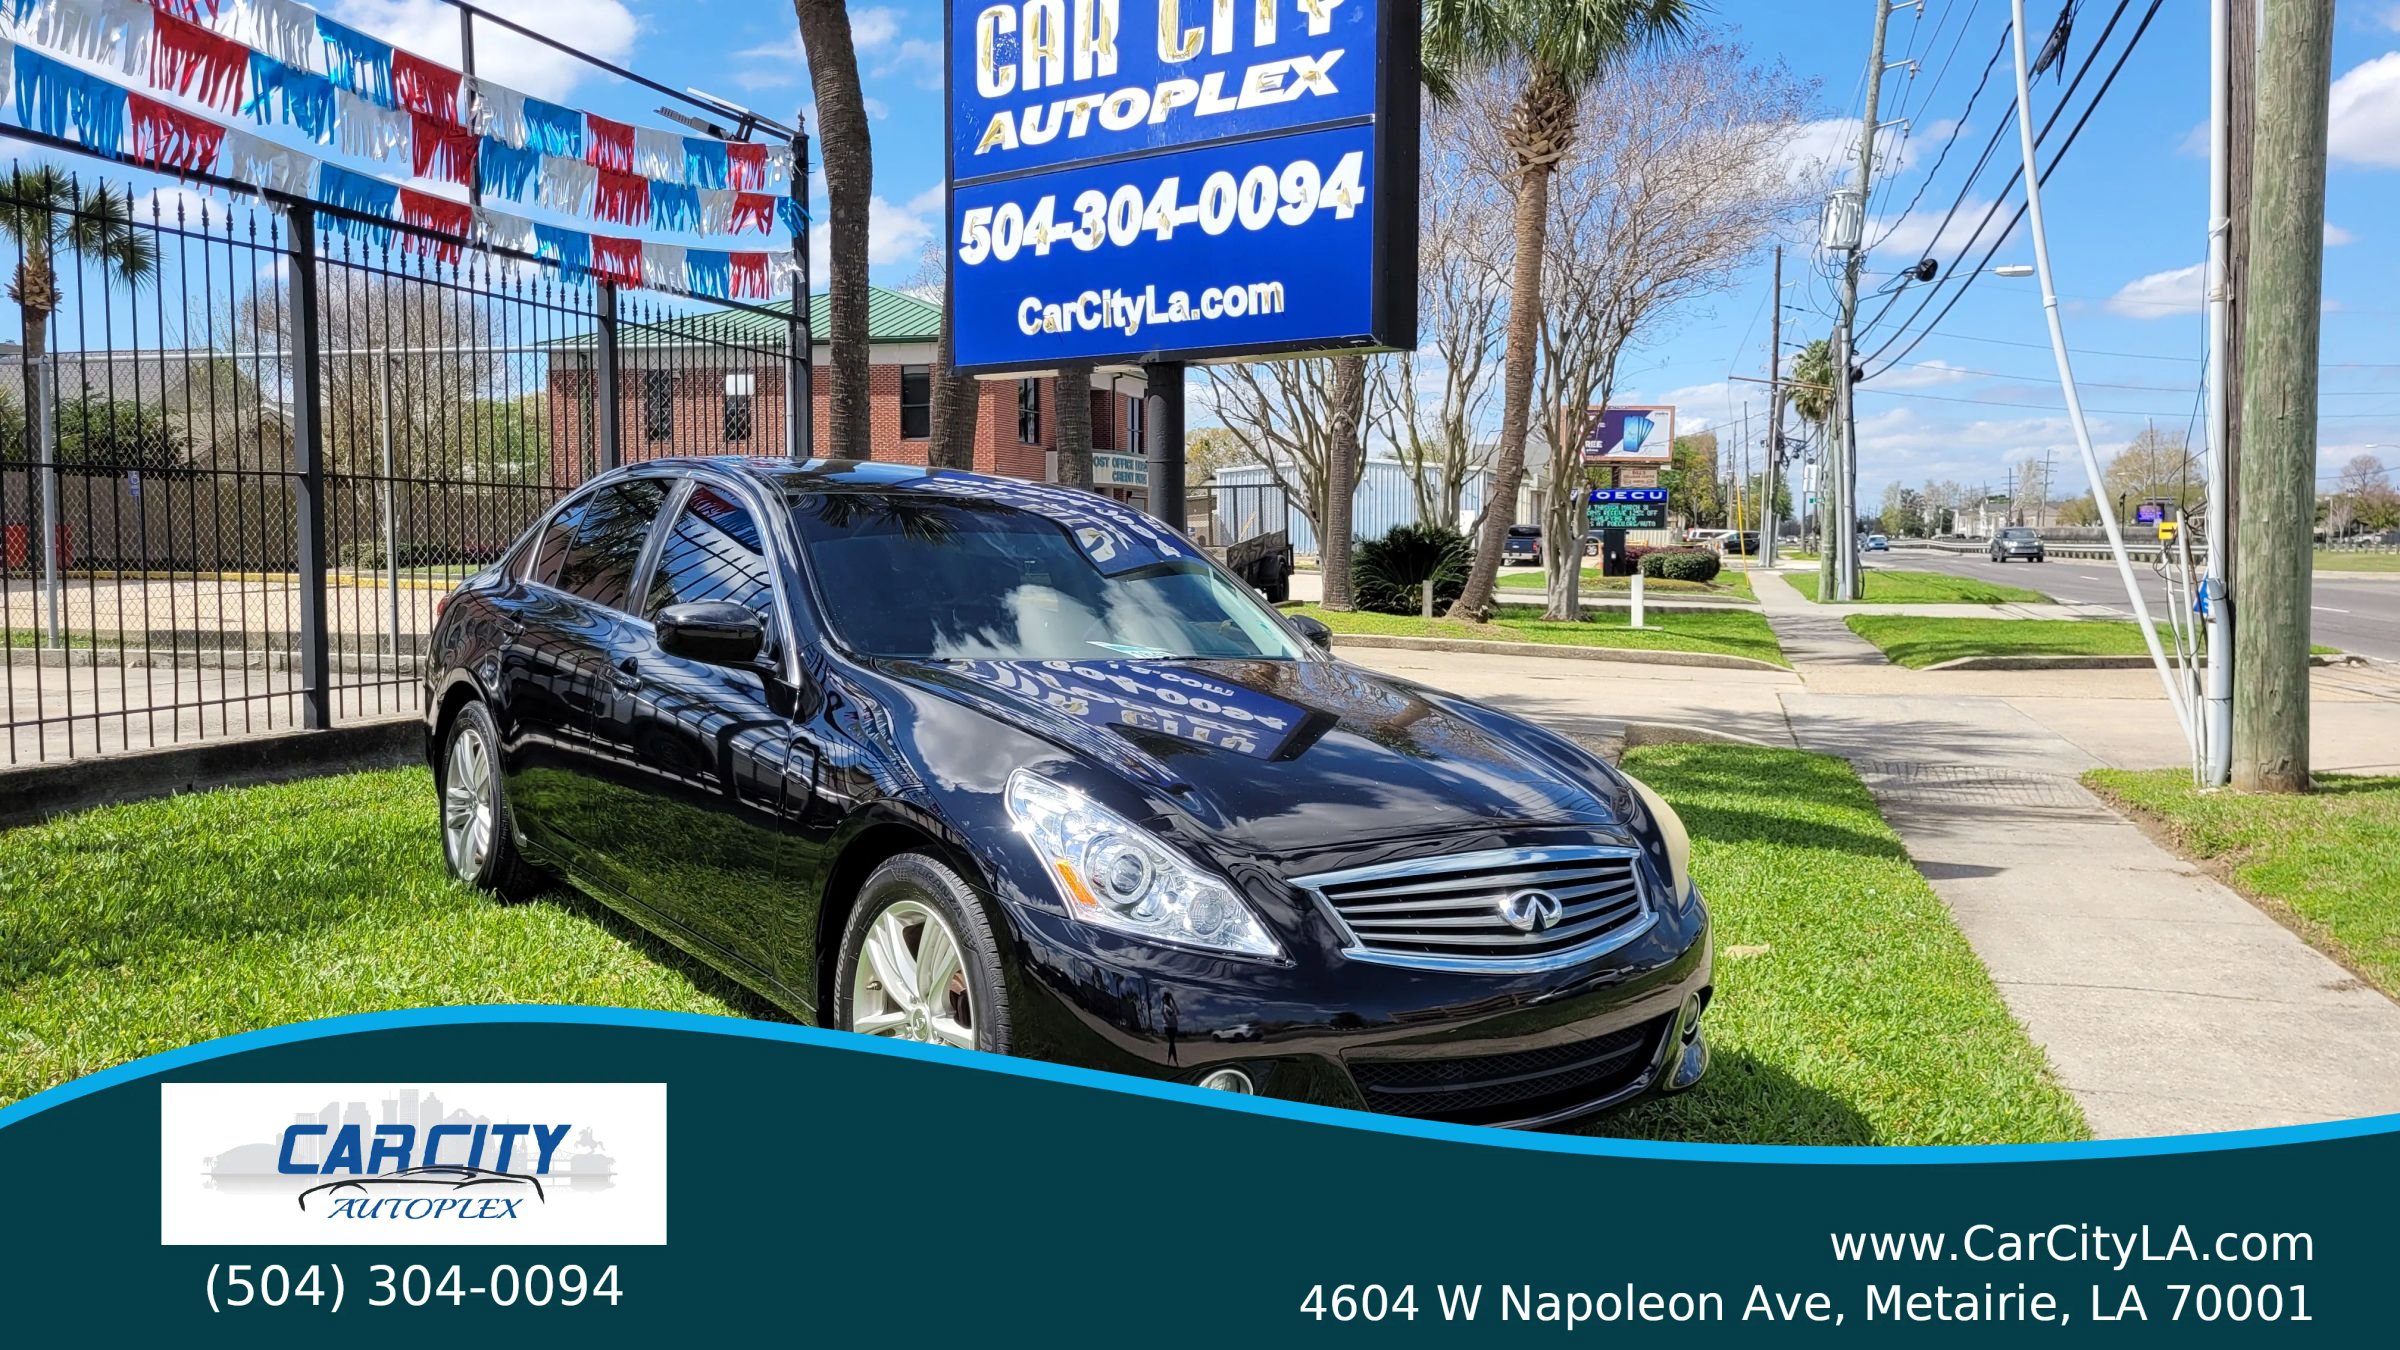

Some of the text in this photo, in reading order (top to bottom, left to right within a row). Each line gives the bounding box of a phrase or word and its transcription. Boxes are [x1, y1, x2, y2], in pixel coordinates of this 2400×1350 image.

[976, 0, 1119, 98] CAR
[974, 48, 1345, 156] AUTOPLEX
[958, 151, 1365, 265] 504-304-0094
[1017, 281, 1285, 337] CarCityLa.com
[1093, 456, 1110, 468] OST
[1595, 491, 1663, 500] OECU
